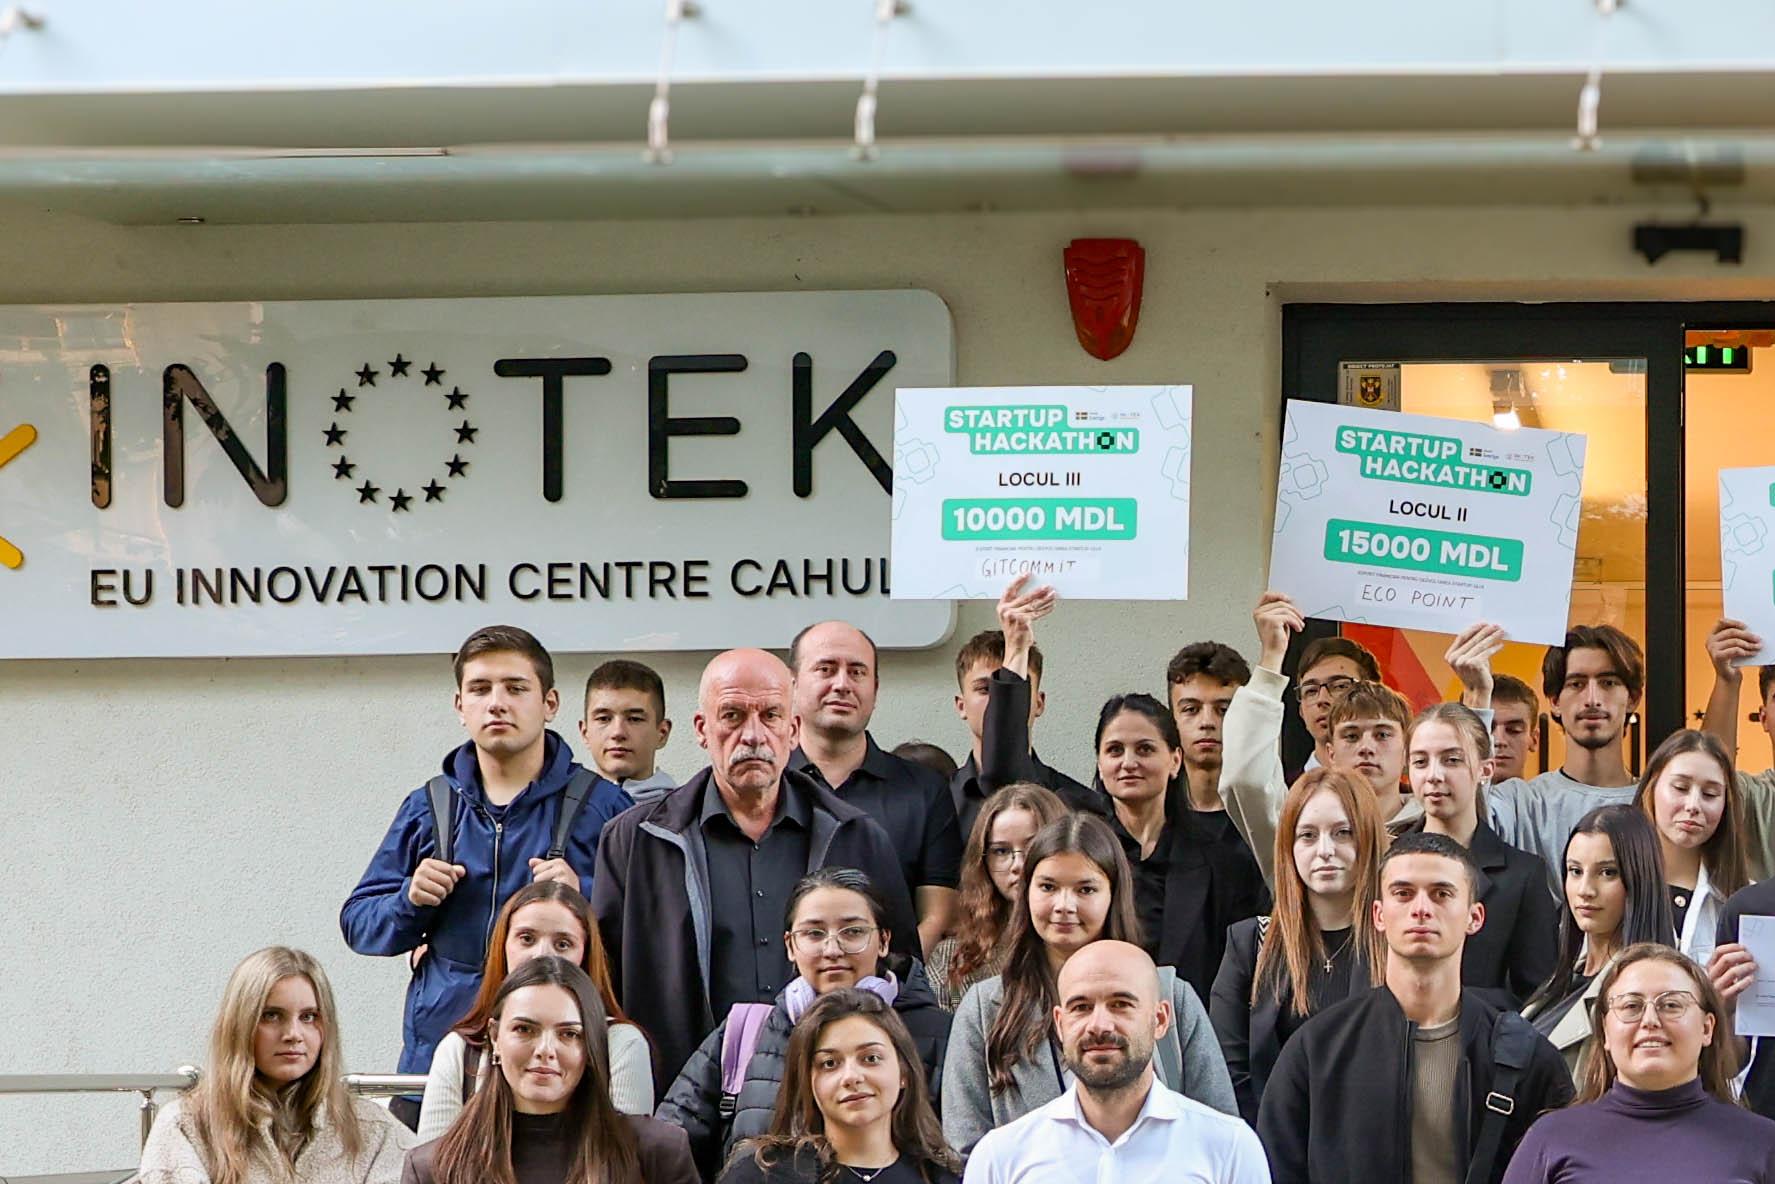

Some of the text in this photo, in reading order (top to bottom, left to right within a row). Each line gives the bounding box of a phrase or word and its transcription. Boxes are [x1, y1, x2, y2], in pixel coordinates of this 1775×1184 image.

[949, 408, 1064, 428] STARTUP
[975, 431, 1133, 451] HACKATHON
[1340, 429, 1457, 459] STARTUP
[998, 472, 1081, 487] LOCUL III
[1365, 456, 1526, 493] HACKATHON
[953, 506, 1124, 532] 10000 MDL
[1389, 499, 1467, 522] LOCUL II
[1338, 529, 1508, 572] 15000 MDL
[982, 559, 1077, 578] GITCOMMIT
[91, 569, 152, 605] EU
[176, 564, 486, 605] INNOVATION
[508, 560, 709, 599] CENTRE
[1362, 584, 1397, 602] ECO
